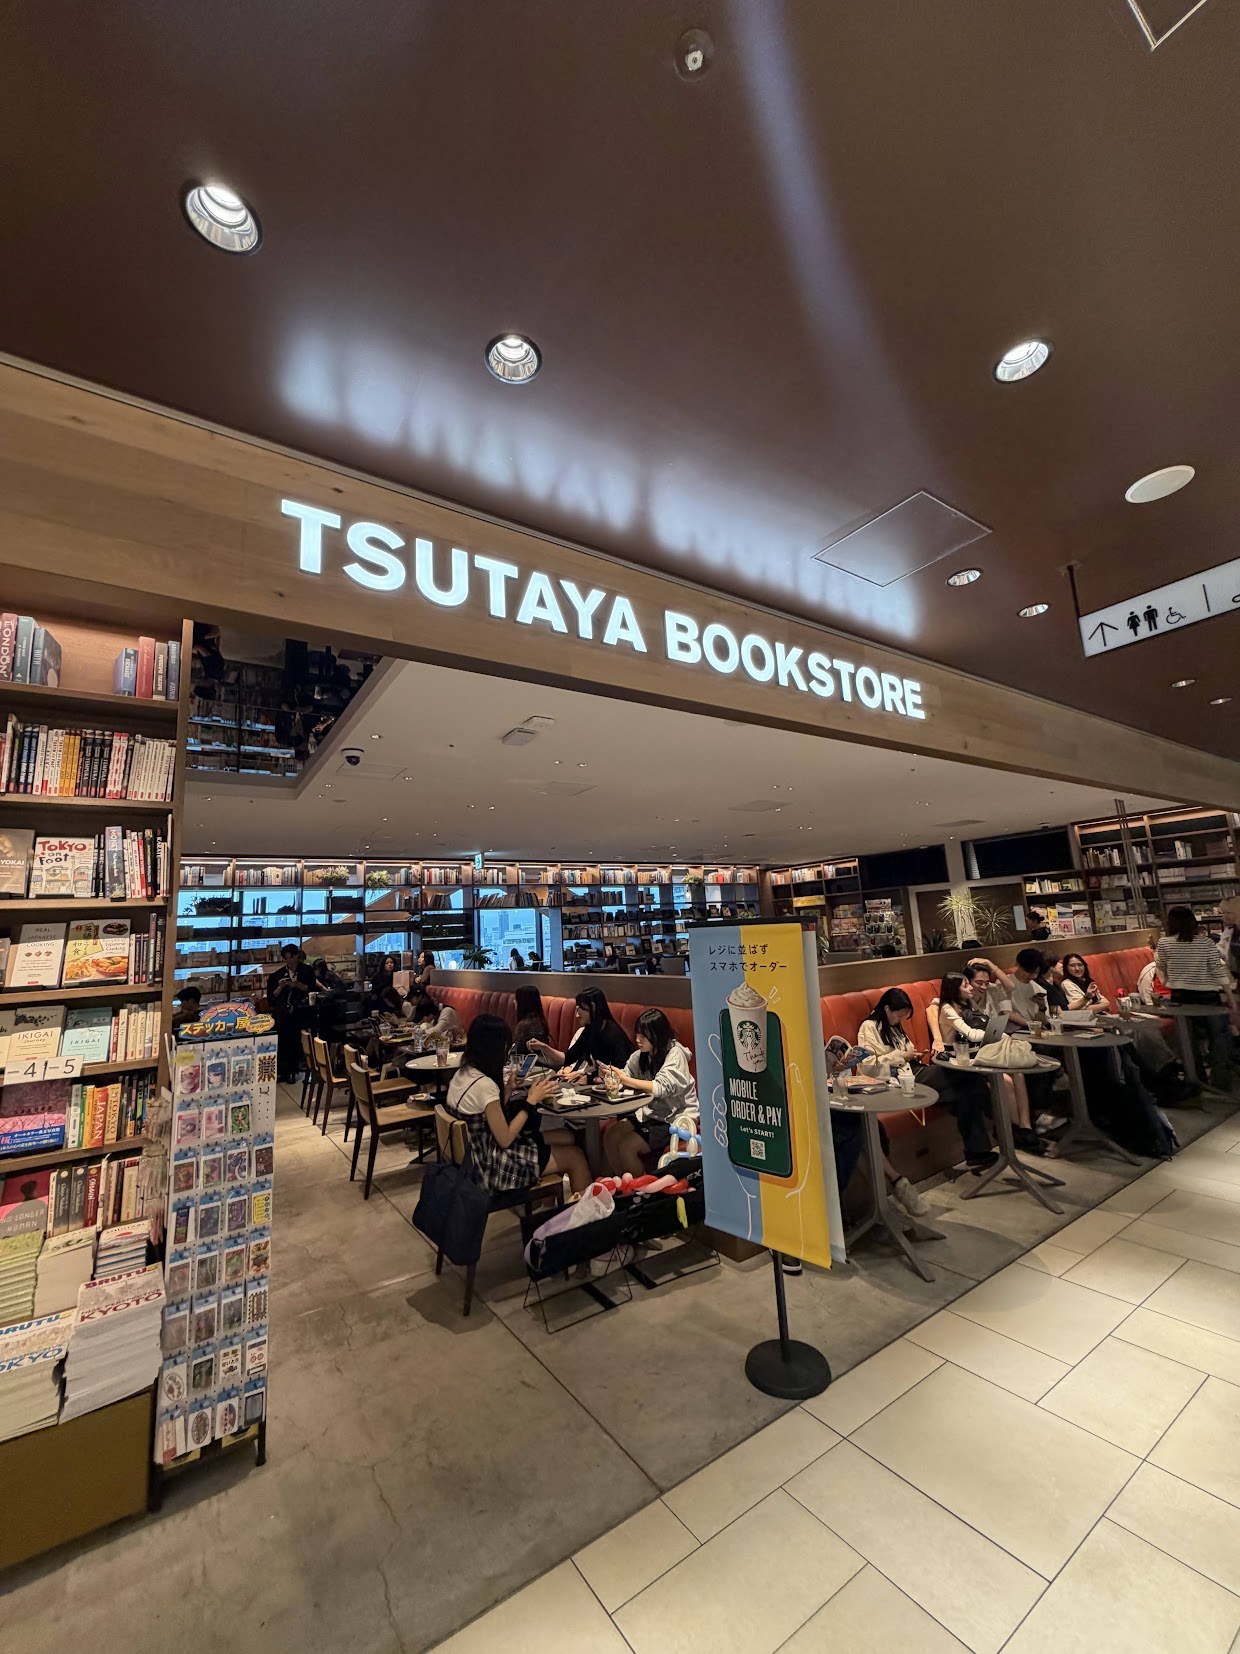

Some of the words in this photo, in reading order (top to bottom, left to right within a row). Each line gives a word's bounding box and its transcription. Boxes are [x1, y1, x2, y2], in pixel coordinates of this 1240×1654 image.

[281, 499, 648, 655] TSUTAYA
[663, 609, 927, 721] BOOKSTORE
[83, 757, 91, 781] TEMPURA
[101, 759, 109, 781] TEMPURA
[708, 944, 769, 956] レジに並ばず
[710, 961, 788, 972] スマホでオーダー
[18, 1030, 54, 1040] IKIGAI
[729, 1078, 759, 1101] MOBILE
[94, 1100, 107, 1140] JAPAN
[110, 1099, 119, 1135] TOKYO
[730, 1099, 757, 1123] ORDER
[758, 1104, 767, 1124] &
[766, 1105, 782, 1128] PAY
[740, 1125, 754, 1135] Let's
[754, 1128, 775, 1139] START!
[84, 1263, 160, 1289] BRUTUS
[80, 1292, 163, 1323] KYOTO
